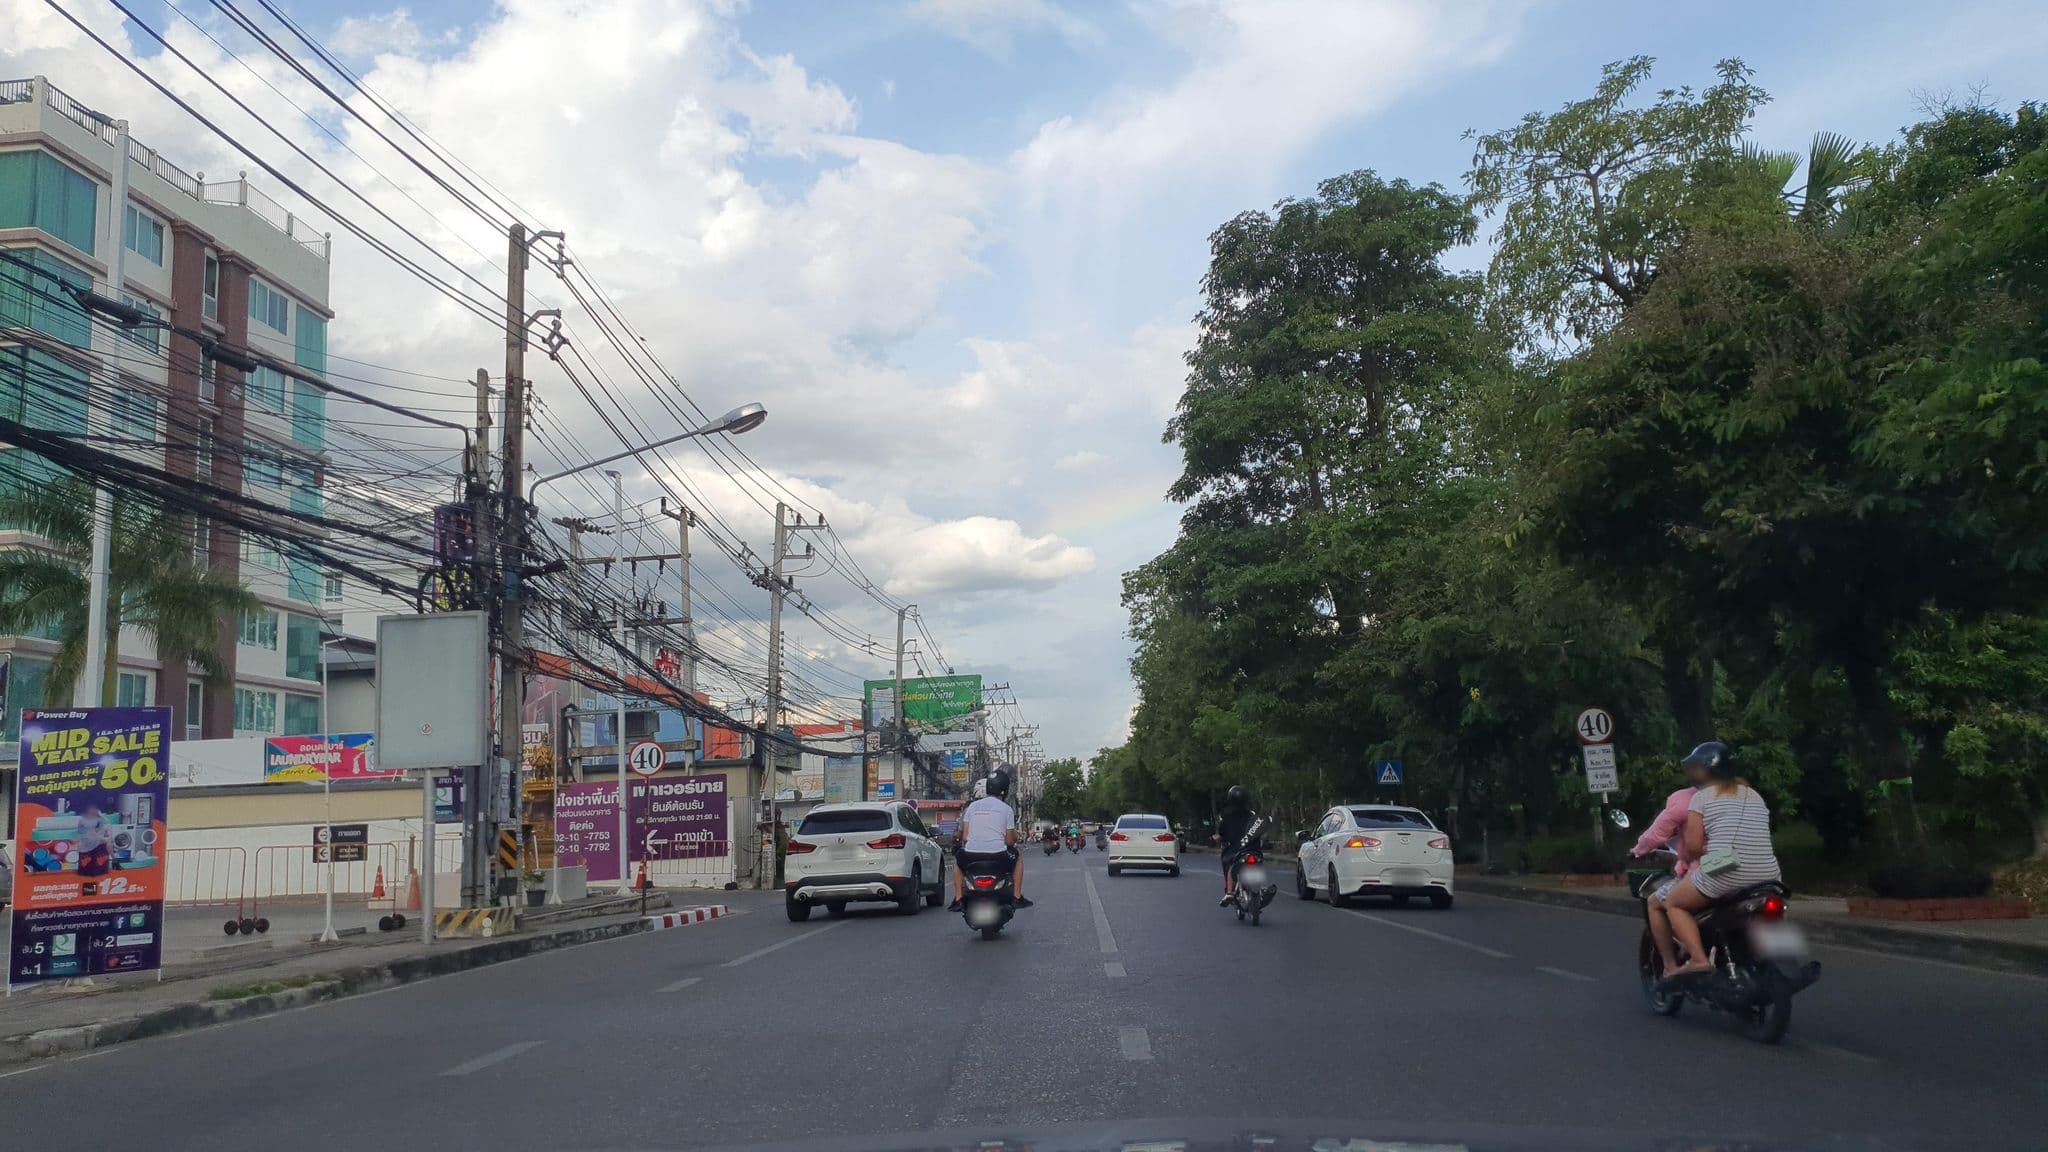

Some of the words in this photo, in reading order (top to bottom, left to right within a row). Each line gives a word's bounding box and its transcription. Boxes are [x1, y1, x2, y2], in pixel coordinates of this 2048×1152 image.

[36, 711, 68, 719] Power
[69, 711, 88, 720] Buy
[1581, 712, 1610, 737] 40
[31, 728, 90, 752] MID
[92, 730, 161, 755] SALE
[34, 747, 90, 766] YEAR
[633, 747, 661, 769] 40
[652, 799, 704, 812] ยินดีต้อนรับ
[569, 820, 594, 831] ติดต่อ
[1247, 817, 1264, 836] YONEX
[674, 828, 714, 842] ทางเข้า
[34, 942, 45, 954] 5
[105, 935, 115, 948] 2
[33, 963, 41, 975] 1
